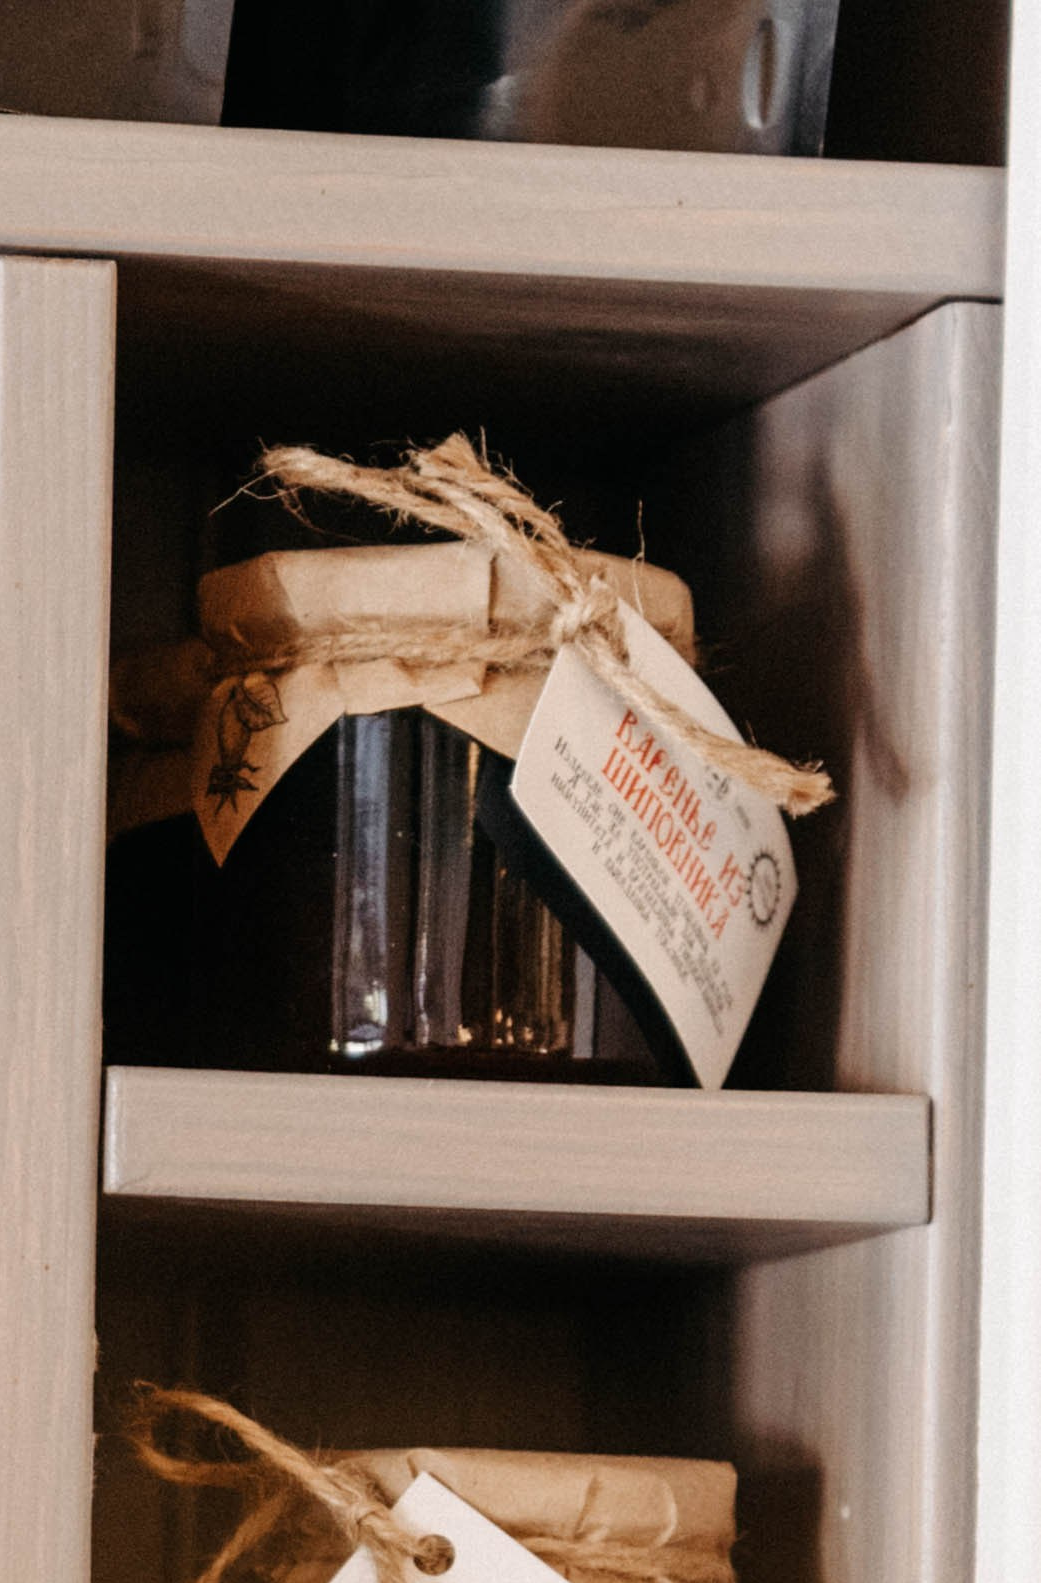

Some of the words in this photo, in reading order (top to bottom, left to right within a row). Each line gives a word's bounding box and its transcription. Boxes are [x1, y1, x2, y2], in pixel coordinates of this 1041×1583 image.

[604, 746, 729, 937] ШИПОВНИКА
[616, 708, 720, 853] ВАРЕНЬЕ
[717, 852, 748, 907] ИЗ
